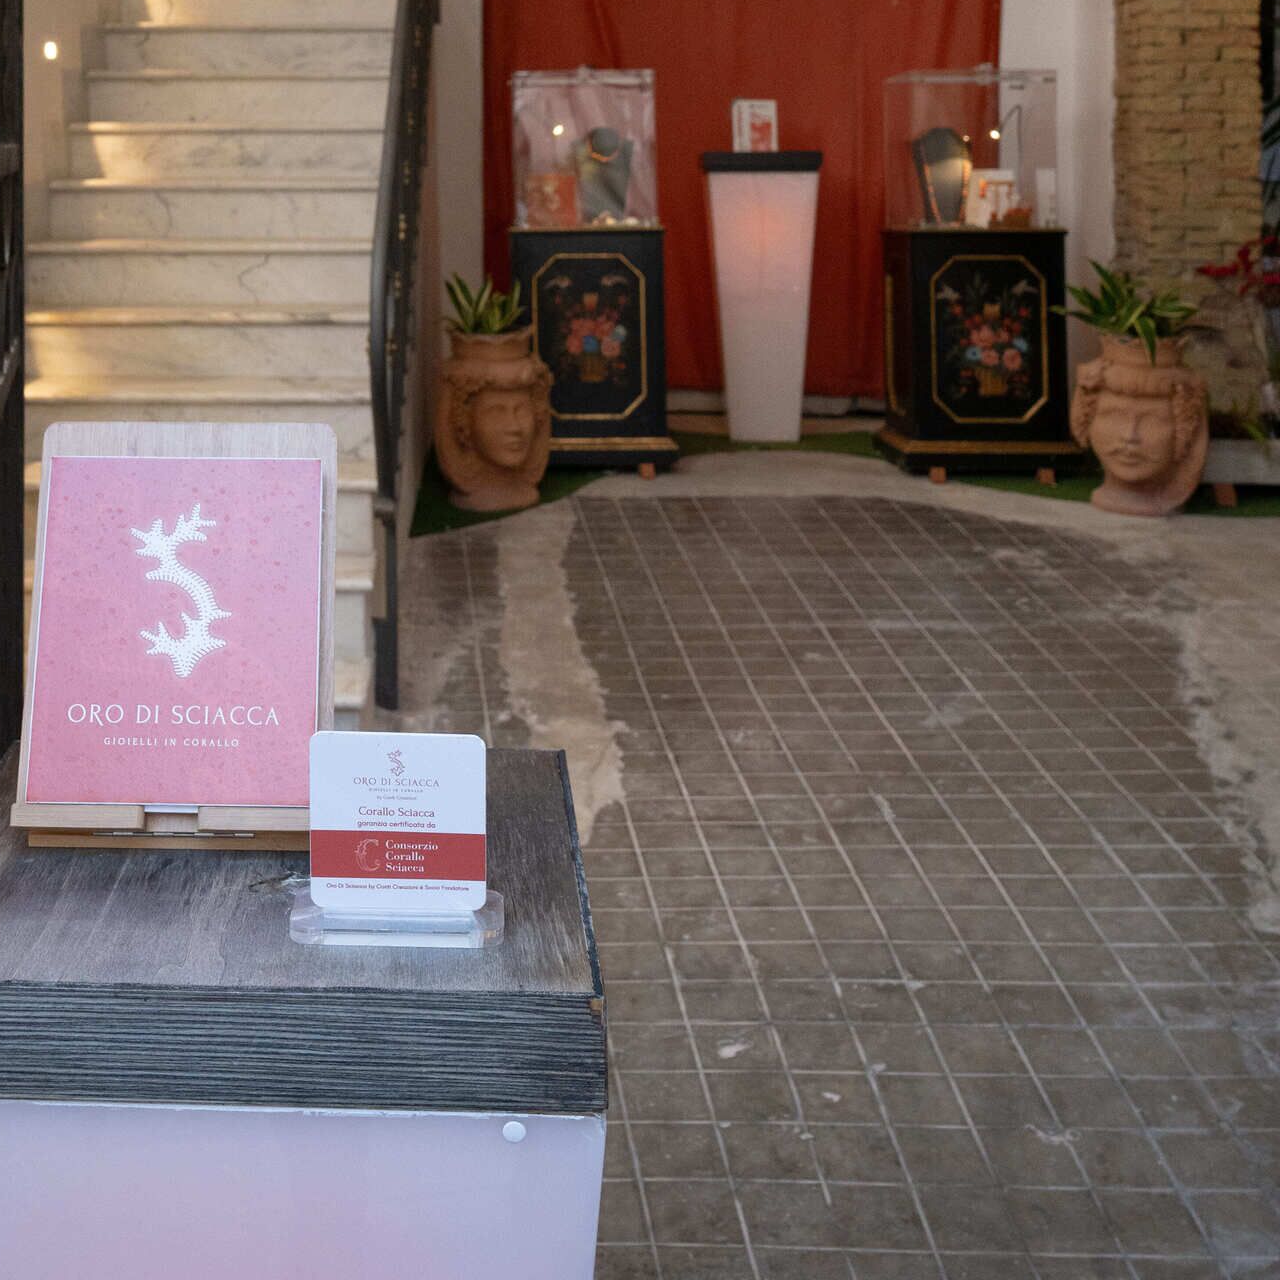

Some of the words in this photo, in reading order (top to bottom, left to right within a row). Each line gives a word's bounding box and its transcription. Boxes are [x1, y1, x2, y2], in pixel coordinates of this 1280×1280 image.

[67, 703, 125, 726] ORO
[135, 704, 160, 724] DI
[171, 705, 280, 726] SCIACCA
[103, 736, 158, 746] GIOIELLI
[164, 737, 177, 747] IN
[183, 737, 240, 748] CORALLO
[353, 776, 377, 787] ORO
[380, 777, 391, 786] DI
[395, 778, 440, 788] SCIACCA
[358, 806, 395, 817] Corallo
[397, 807, 435, 818] Sciacca
[357, 820, 388, 829] garanzia
[389, 819, 425, 828] certificata
[426, 821, 436, 829] da
[385, 839, 439, 851] Consorzio
[385, 851, 425, 862] Corallo
[385, 862, 425, 873] Sciacca
